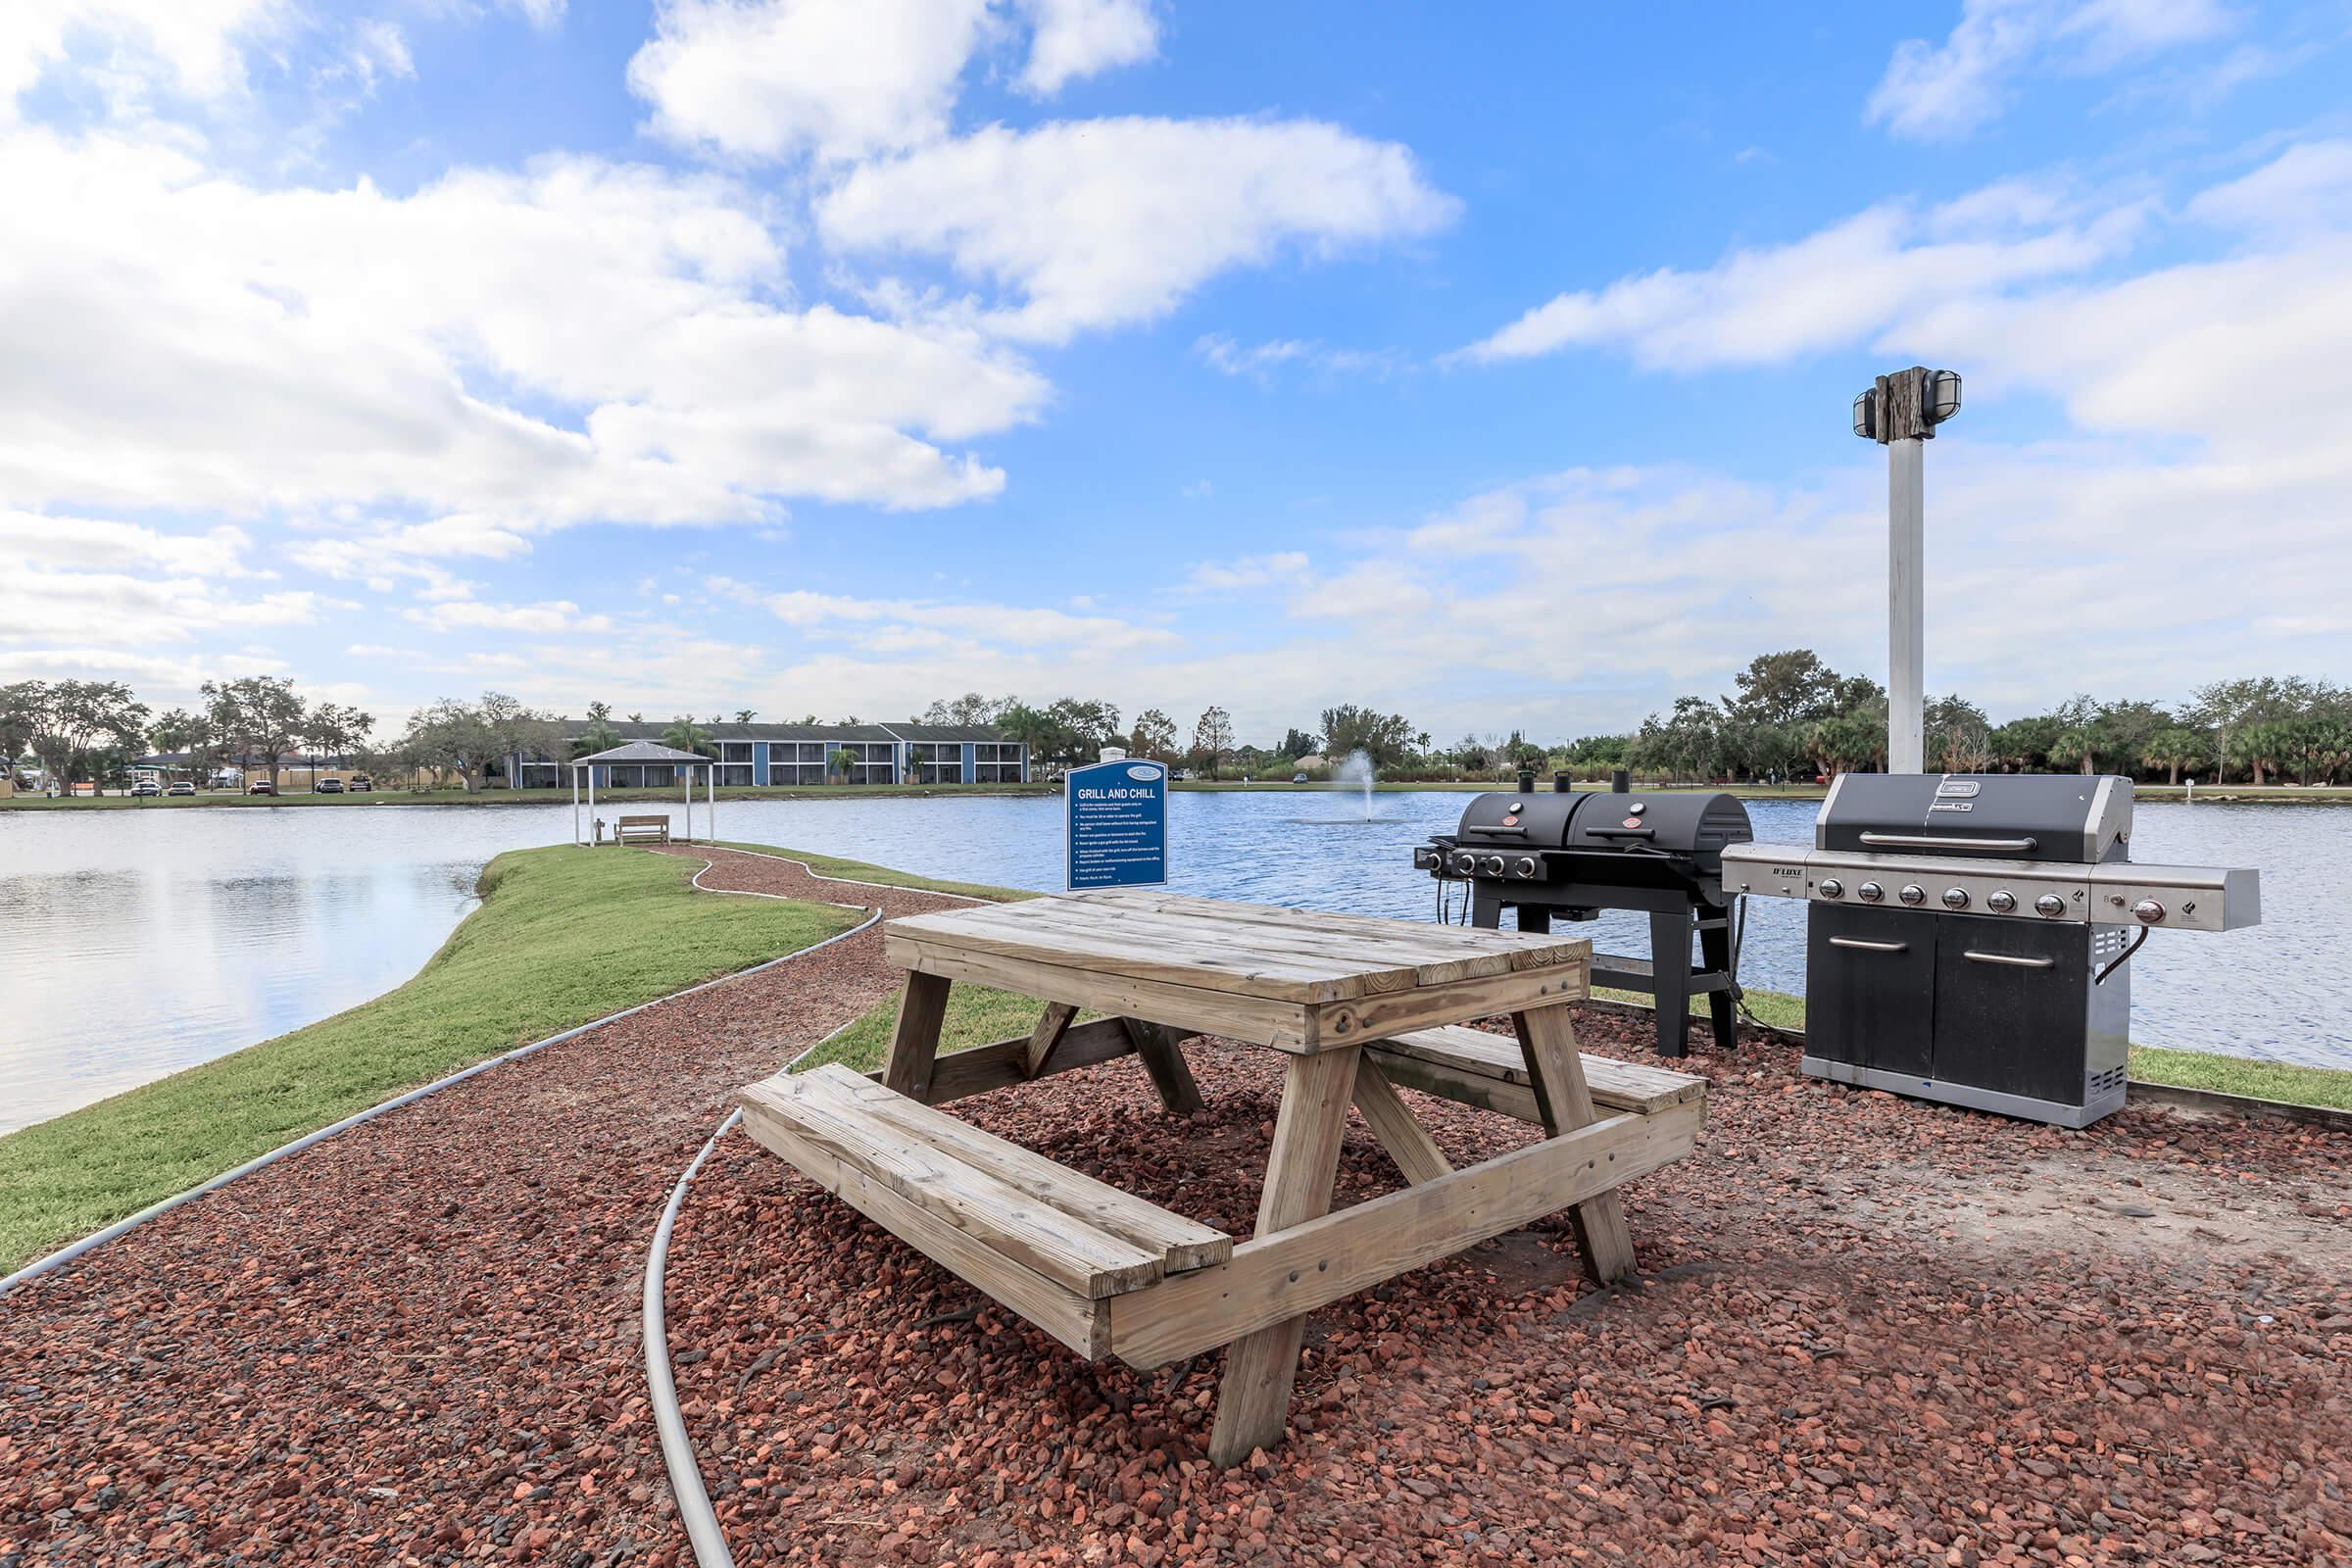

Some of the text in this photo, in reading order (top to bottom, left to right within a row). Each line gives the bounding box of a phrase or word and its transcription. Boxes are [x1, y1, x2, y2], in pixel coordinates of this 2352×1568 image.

[1078, 788, 1155, 799] GRILL AND CHILL
